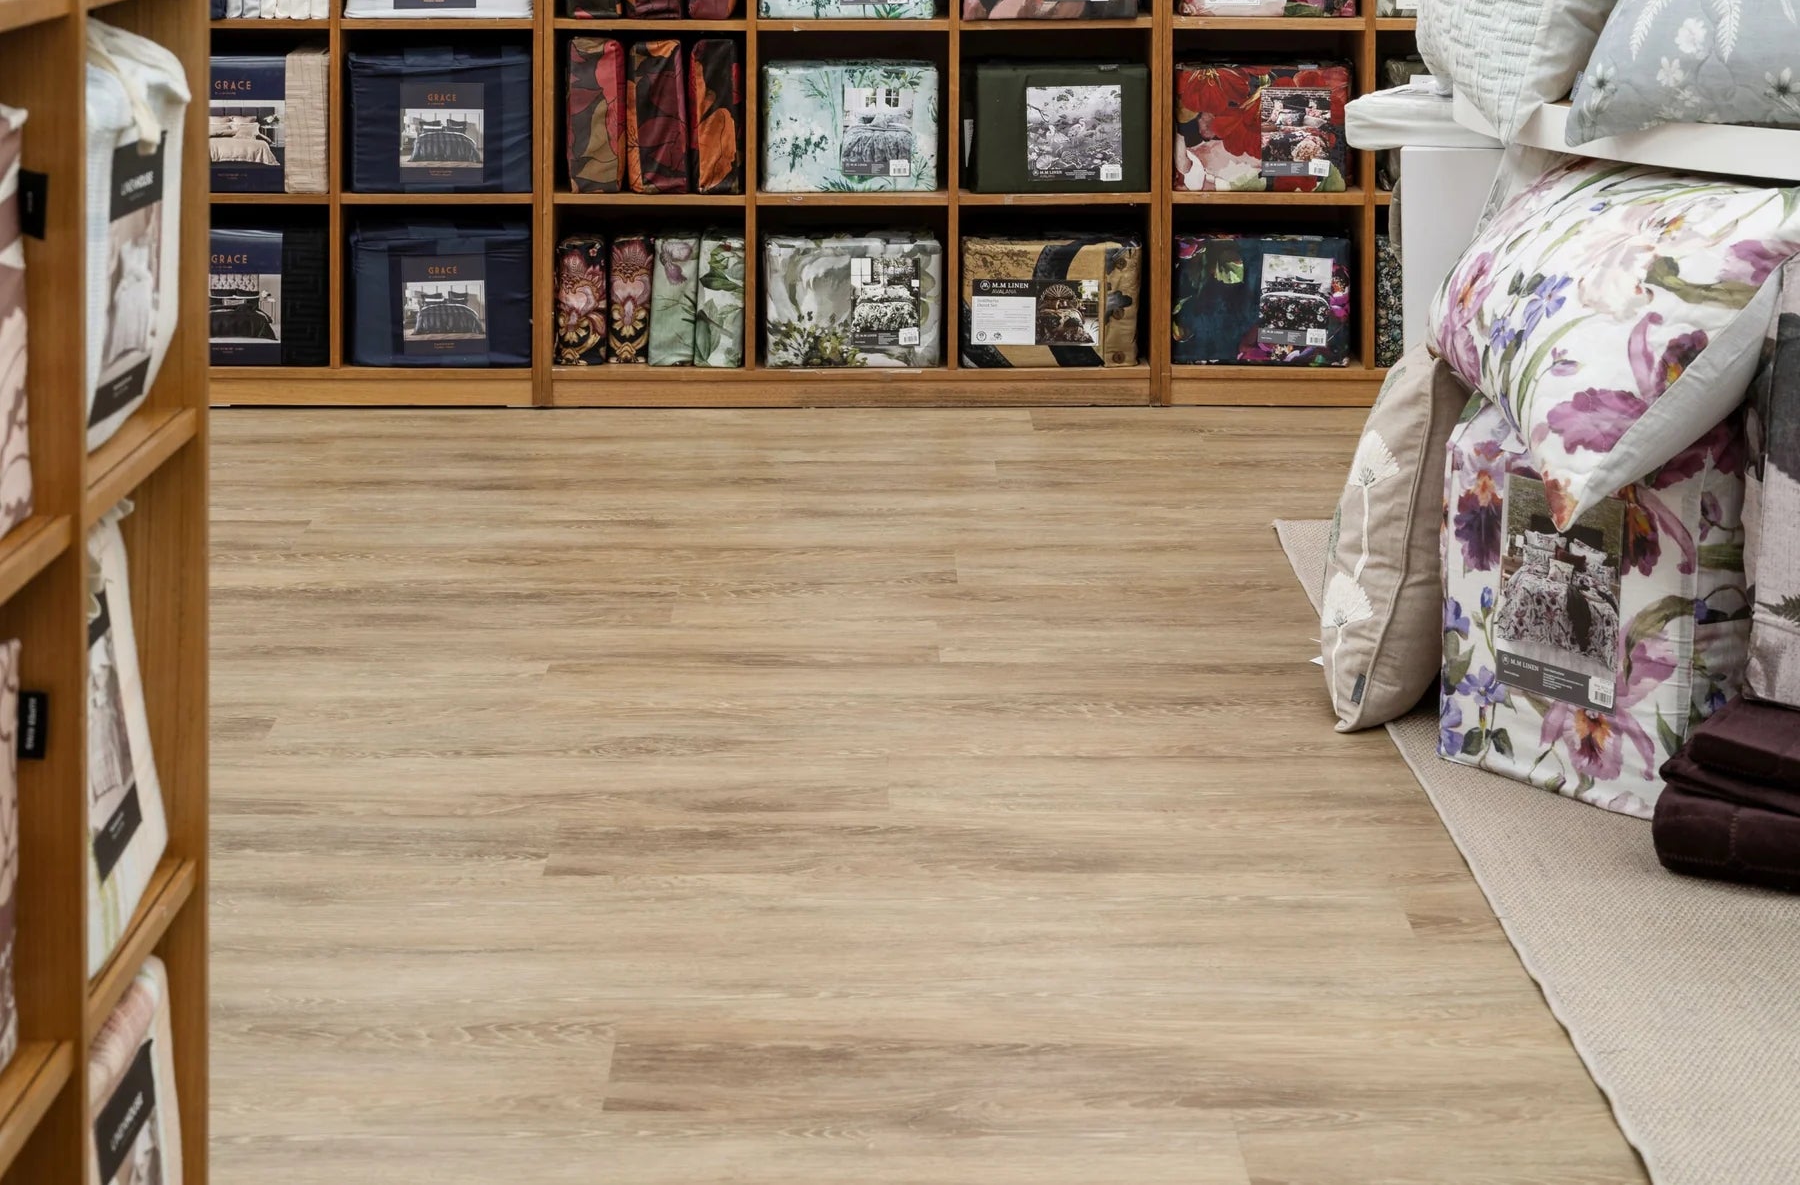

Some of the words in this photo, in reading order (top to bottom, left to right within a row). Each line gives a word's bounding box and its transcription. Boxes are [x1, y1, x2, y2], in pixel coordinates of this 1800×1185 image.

[215, 80, 252, 90] GRACE
[427, 93, 457, 102] GRACE
[211, 254, 248, 264] GRACE
[428, 266, 457, 275] GRACE
[1510, 658, 1521, 667] M.M
[1522, 662, 1539, 672] LINEN
